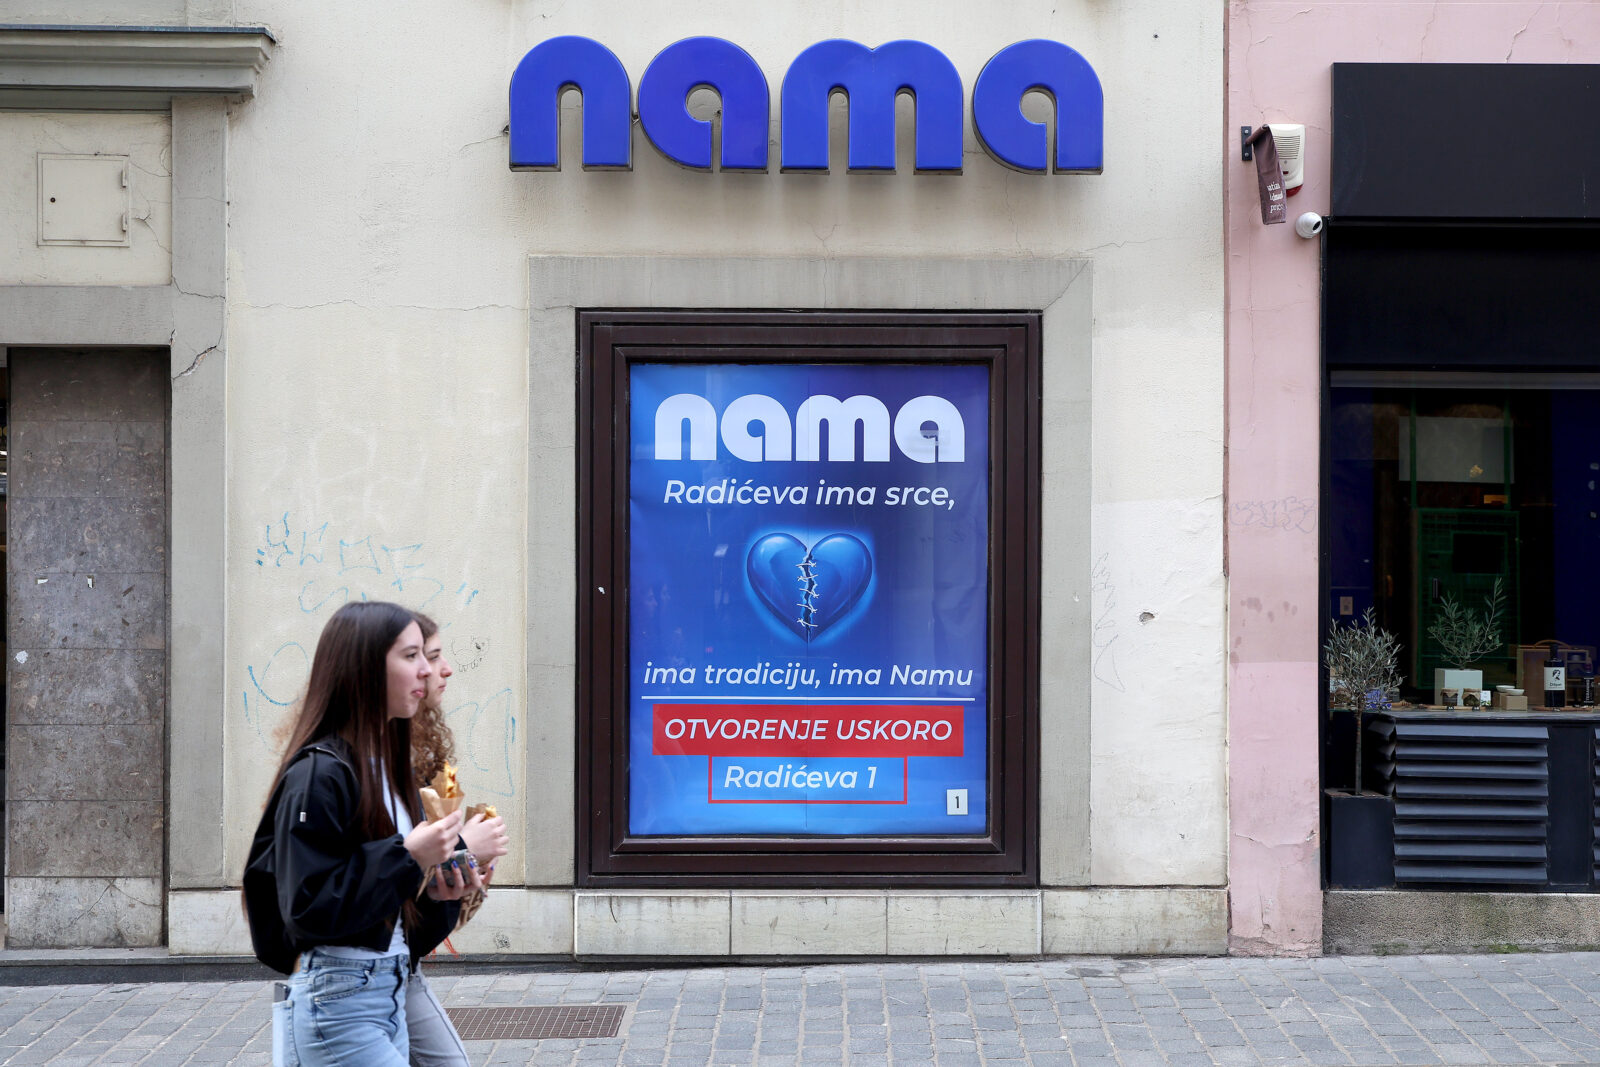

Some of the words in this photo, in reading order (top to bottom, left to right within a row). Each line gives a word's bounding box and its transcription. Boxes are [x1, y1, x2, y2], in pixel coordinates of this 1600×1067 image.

[509, 35, 1103, 174] nama
[655, 394, 964, 463] nama
[664, 479, 808, 504] Radićeva
[816, 480, 875, 504] ima
[885, 486, 955, 509] srce,
[644, 662, 696, 684] ima
[705, 663, 821, 689] tradiciju,
[830, 663, 881, 685] ima
[890, 664, 973, 686] Namu
[665, 719, 828, 739] OTVORENJE
[837, 720, 952, 740] USKORO
[725, 764, 858, 788] Radićeva
[867, 766, 877, 788] 1
[954, 796, 960, 809] 1
